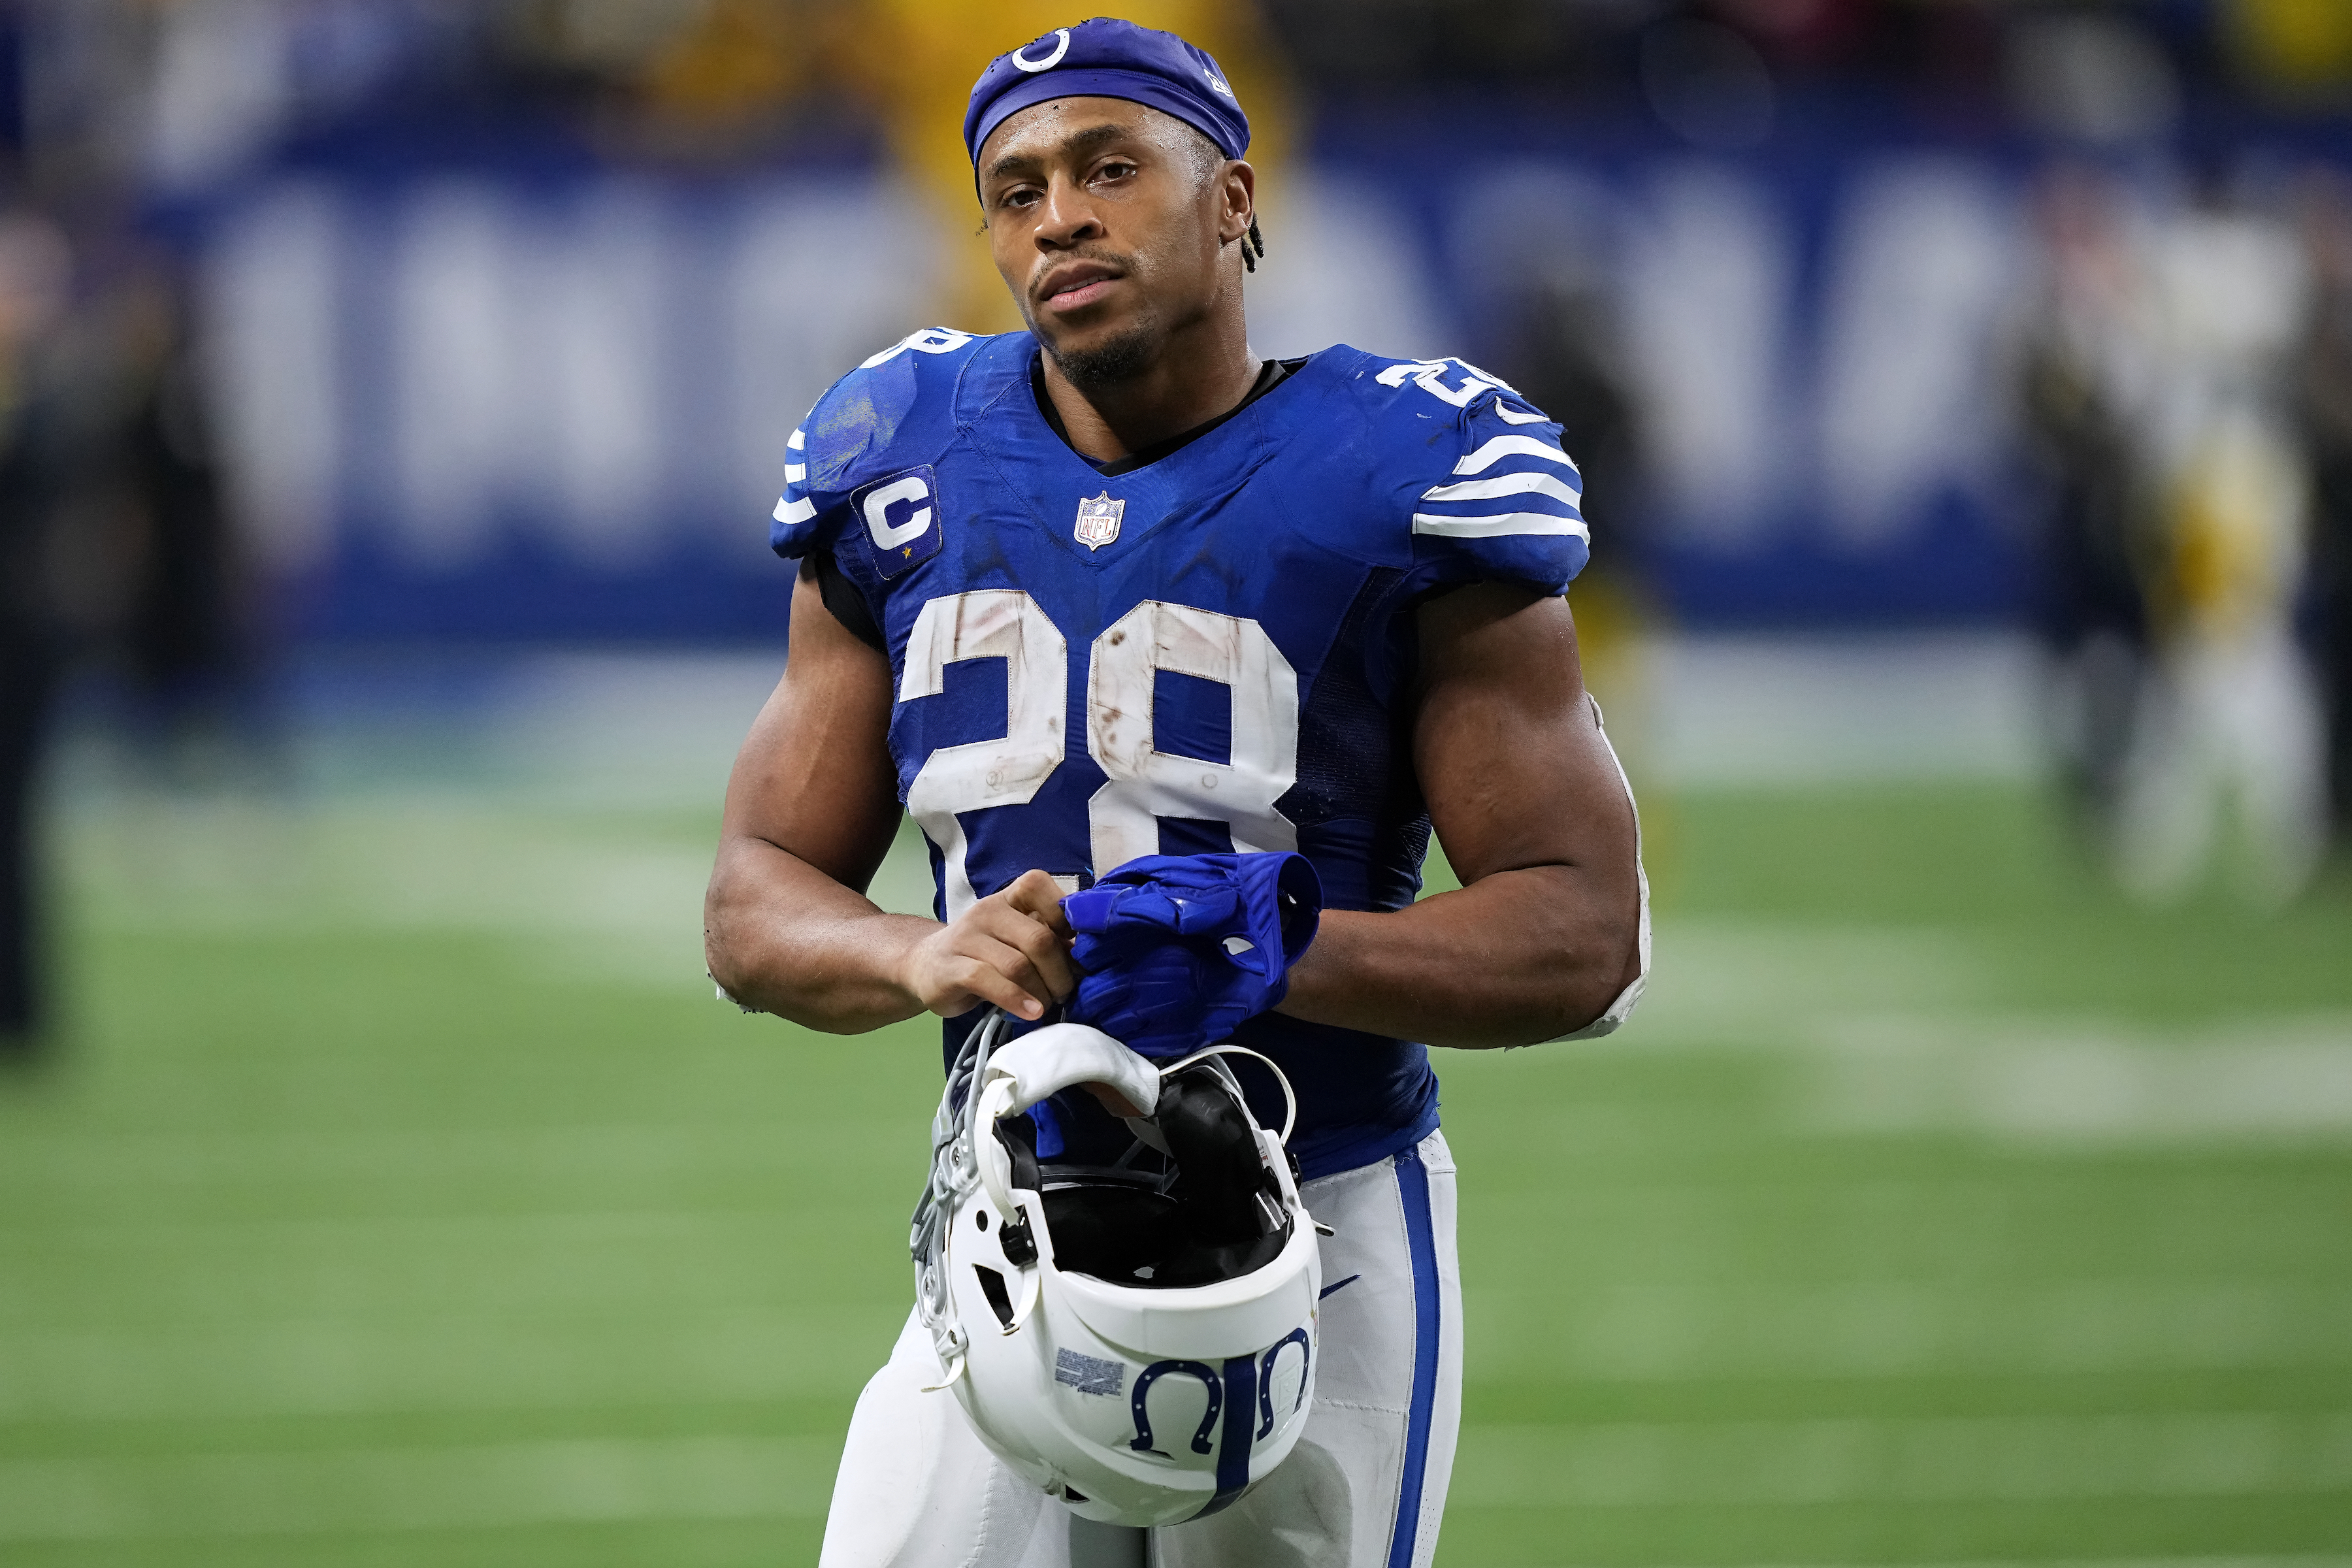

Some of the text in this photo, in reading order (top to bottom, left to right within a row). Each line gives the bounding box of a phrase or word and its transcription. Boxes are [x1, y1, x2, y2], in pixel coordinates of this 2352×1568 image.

[863, 476, 932, 551] C
[1080, 517, 1112, 540] NFL
[898, 589, 1299, 925] 28
